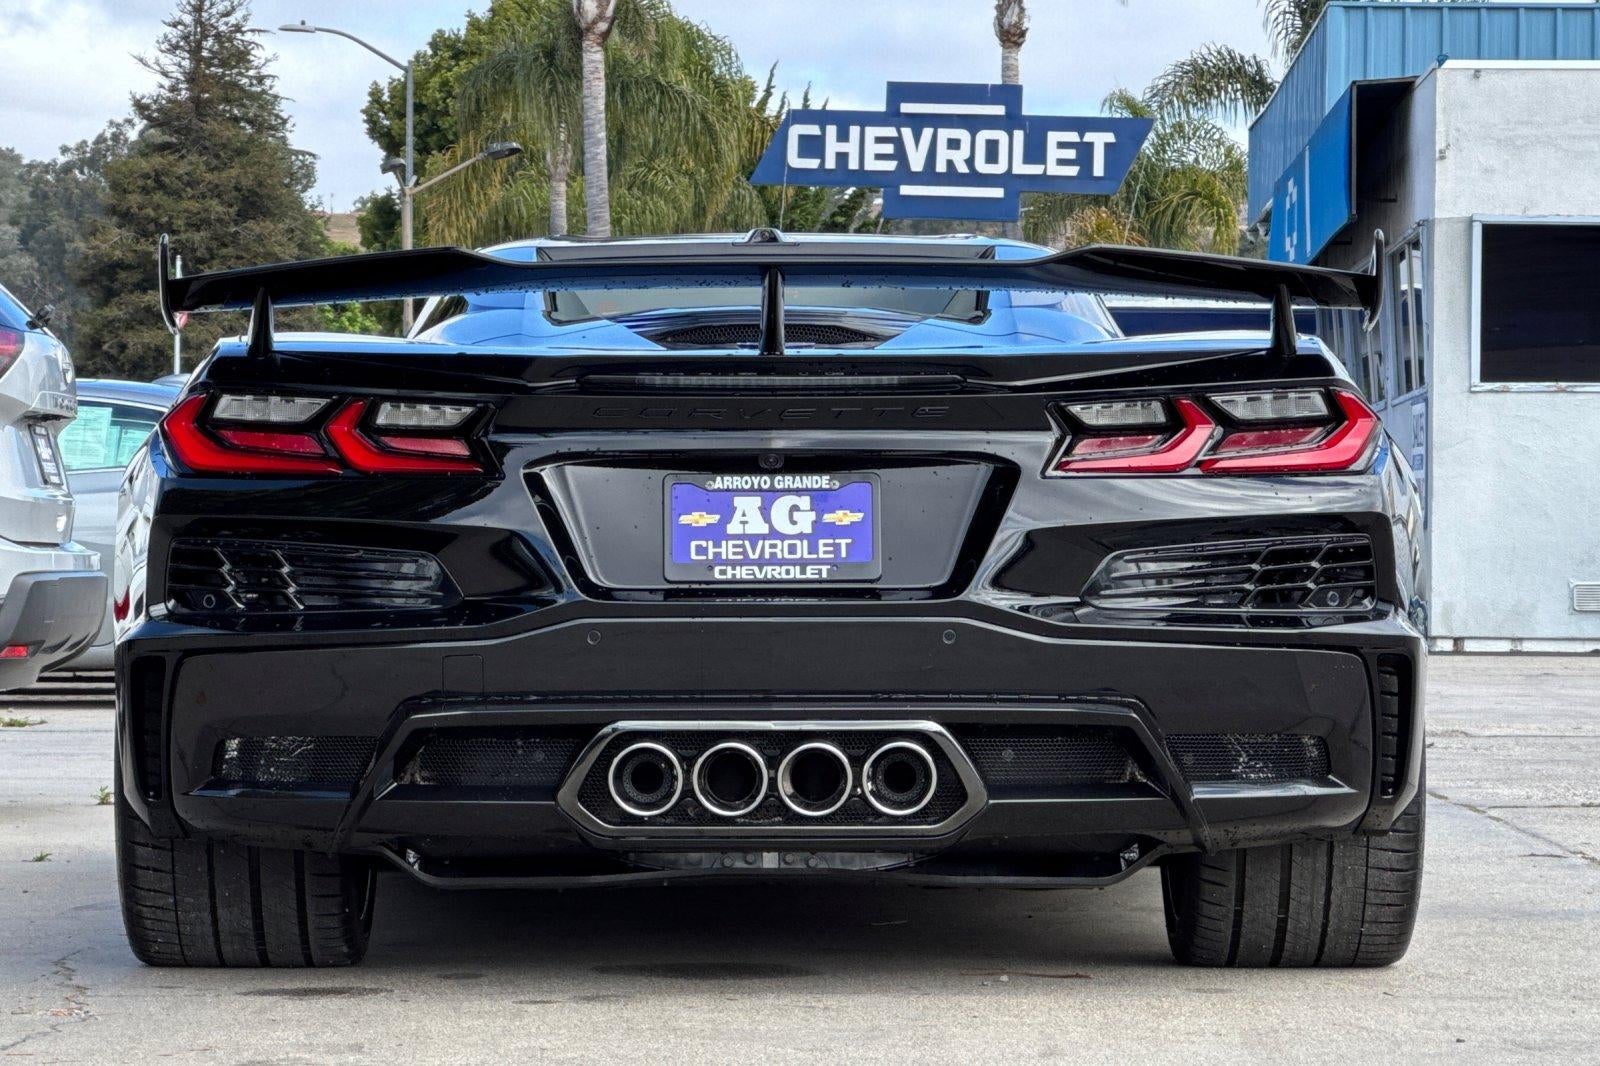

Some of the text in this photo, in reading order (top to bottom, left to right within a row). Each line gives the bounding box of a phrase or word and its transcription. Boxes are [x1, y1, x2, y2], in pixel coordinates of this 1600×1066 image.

[787, 124, 1116, 177] CHEVROLET
[592, 406, 950, 420] CORVETTE
[714, 475, 830, 489] ARROYO GRANDE
[726, 495, 816, 535] AG
[690, 538, 852, 560] CHEVROLET
[714, 565, 830, 579] CHEVROLET
